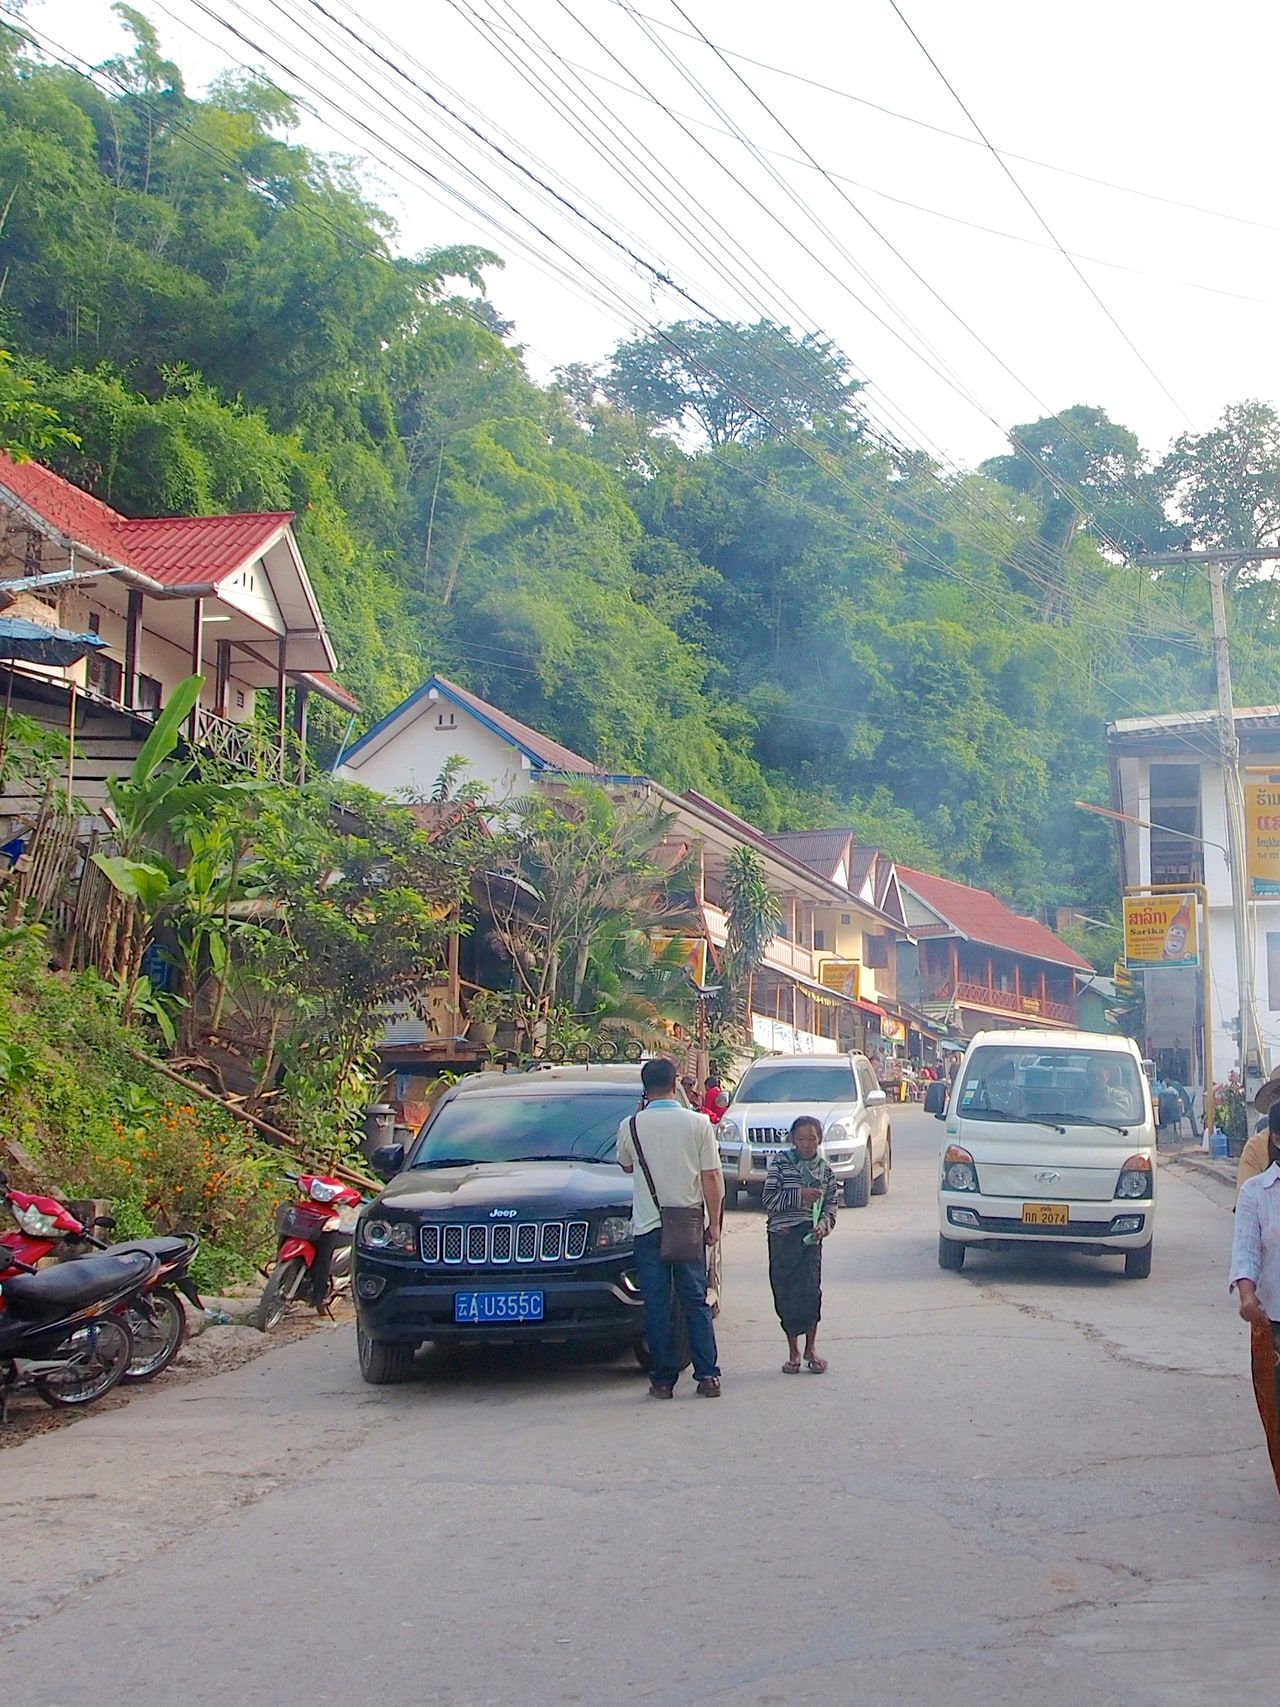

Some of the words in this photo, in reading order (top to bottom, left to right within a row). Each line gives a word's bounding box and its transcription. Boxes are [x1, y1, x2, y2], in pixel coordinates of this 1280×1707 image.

[1130, 928, 1164, 936] Sarika
[489, 1208, 518, 1218] Jeep
[1041, 1213, 1065, 1224] 2074
